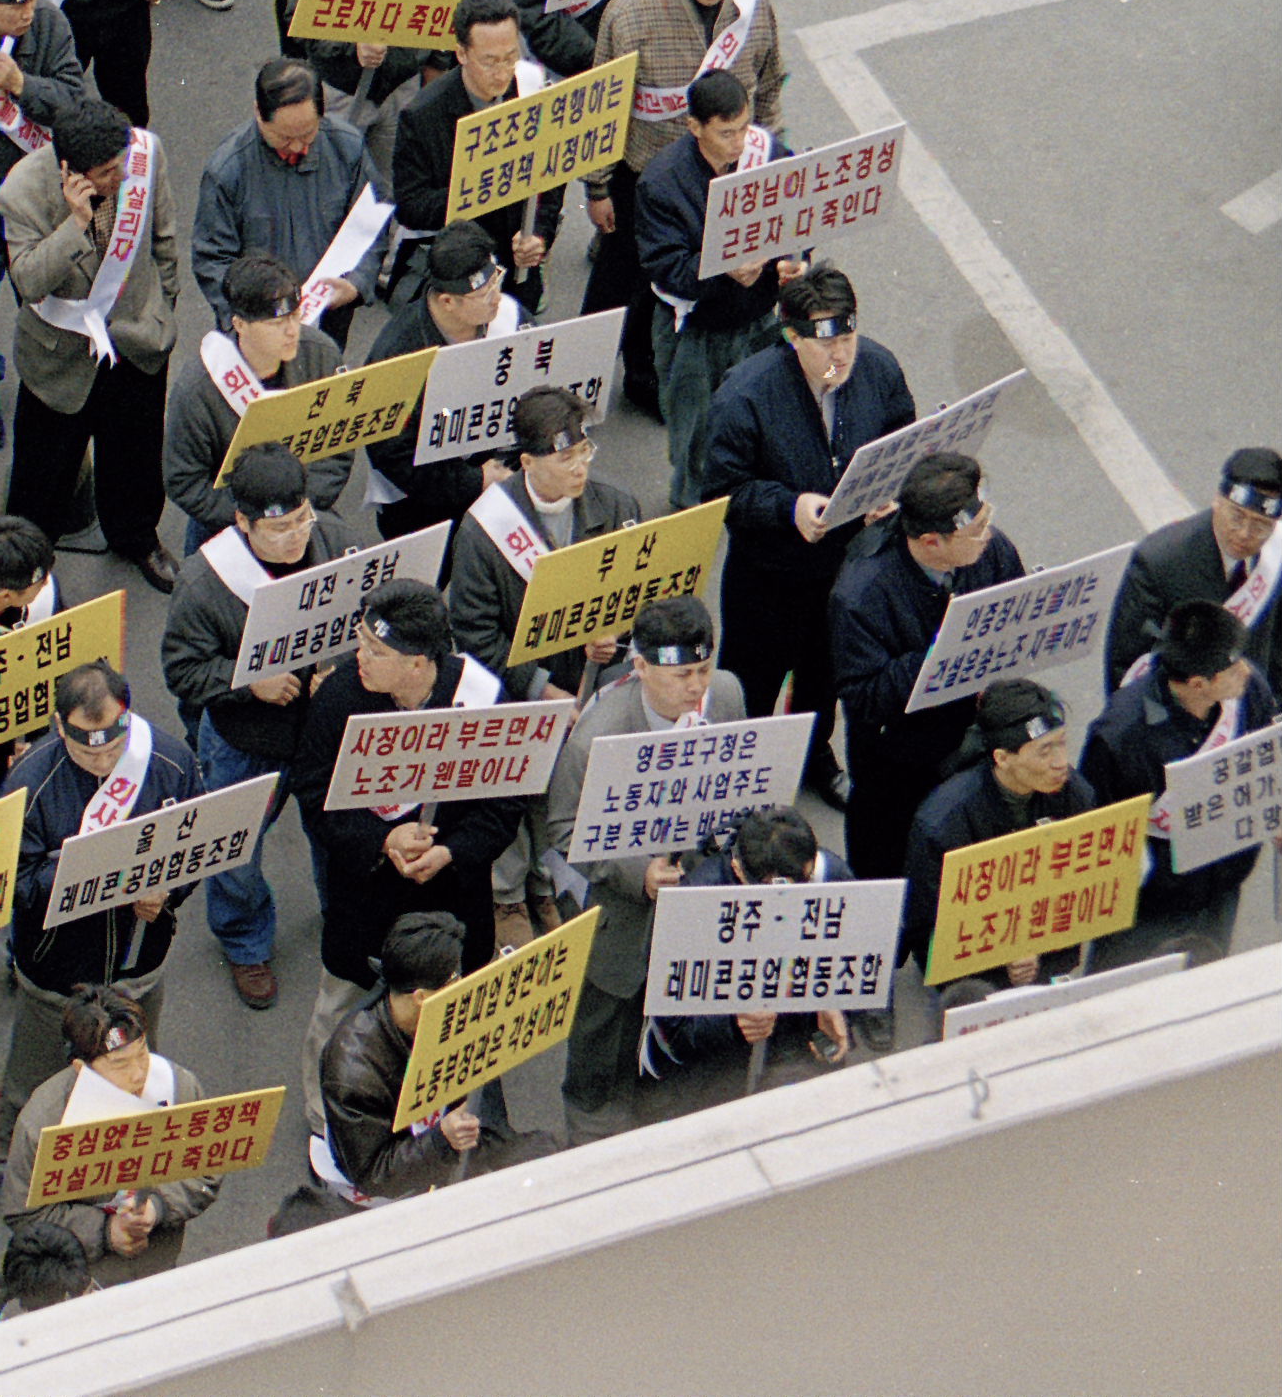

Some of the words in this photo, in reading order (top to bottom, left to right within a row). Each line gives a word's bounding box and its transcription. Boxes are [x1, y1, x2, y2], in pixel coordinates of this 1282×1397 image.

[380, 3, 402, 33] 다
[465, 103, 542, 162] 구조조정
[551, 75, 623, 128] 역행하는
[457, 152, 534, 211] 노동정책
[540, 120, 617, 177] 시정하라
[719, 168, 806, 217] 사장님이
[111, 187, 146, 261] 살리자
[722, 215, 783, 260] 근로자
[796, 206, 814, 236] 다
[822, 185, 882, 227] 죽인다
[351, 723, 449, 756] 사장이라
[457, 714, 556, 749] 부르면서
[637, 731, 757, 773] 영등포구청은
[351, 763, 425, 795] 노조가
[432, 755, 529, 790] 웬말이냐
[603, 778, 687, 813] 노동자와
[693, 767, 772, 801] 사업주도
[584, 823, 621, 852] 구분
[629, 816, 689, 847] 못하는
[952, 846, 1041, 905] 사장이라
[1050, 819, 1137, 878] 부르면서
[954, 906, 1021, 960] 노조가
[439, 974, 503, 1043] 불법파업
[505, 947, 568, 1007] 방관하는
[409, 1024, 505, 1111] 노동부장관은
[509, 987, 571, 1051] 각성하라
[53, 1122, 152, 1161] 중심없는
[161, 1100, 261, 1142] 노동정책
[42, 1156, 143, 1197] 건설기업
[150, 1150, 173, 1176] 다
[182, 1136, 254, 1170] 죽인다
